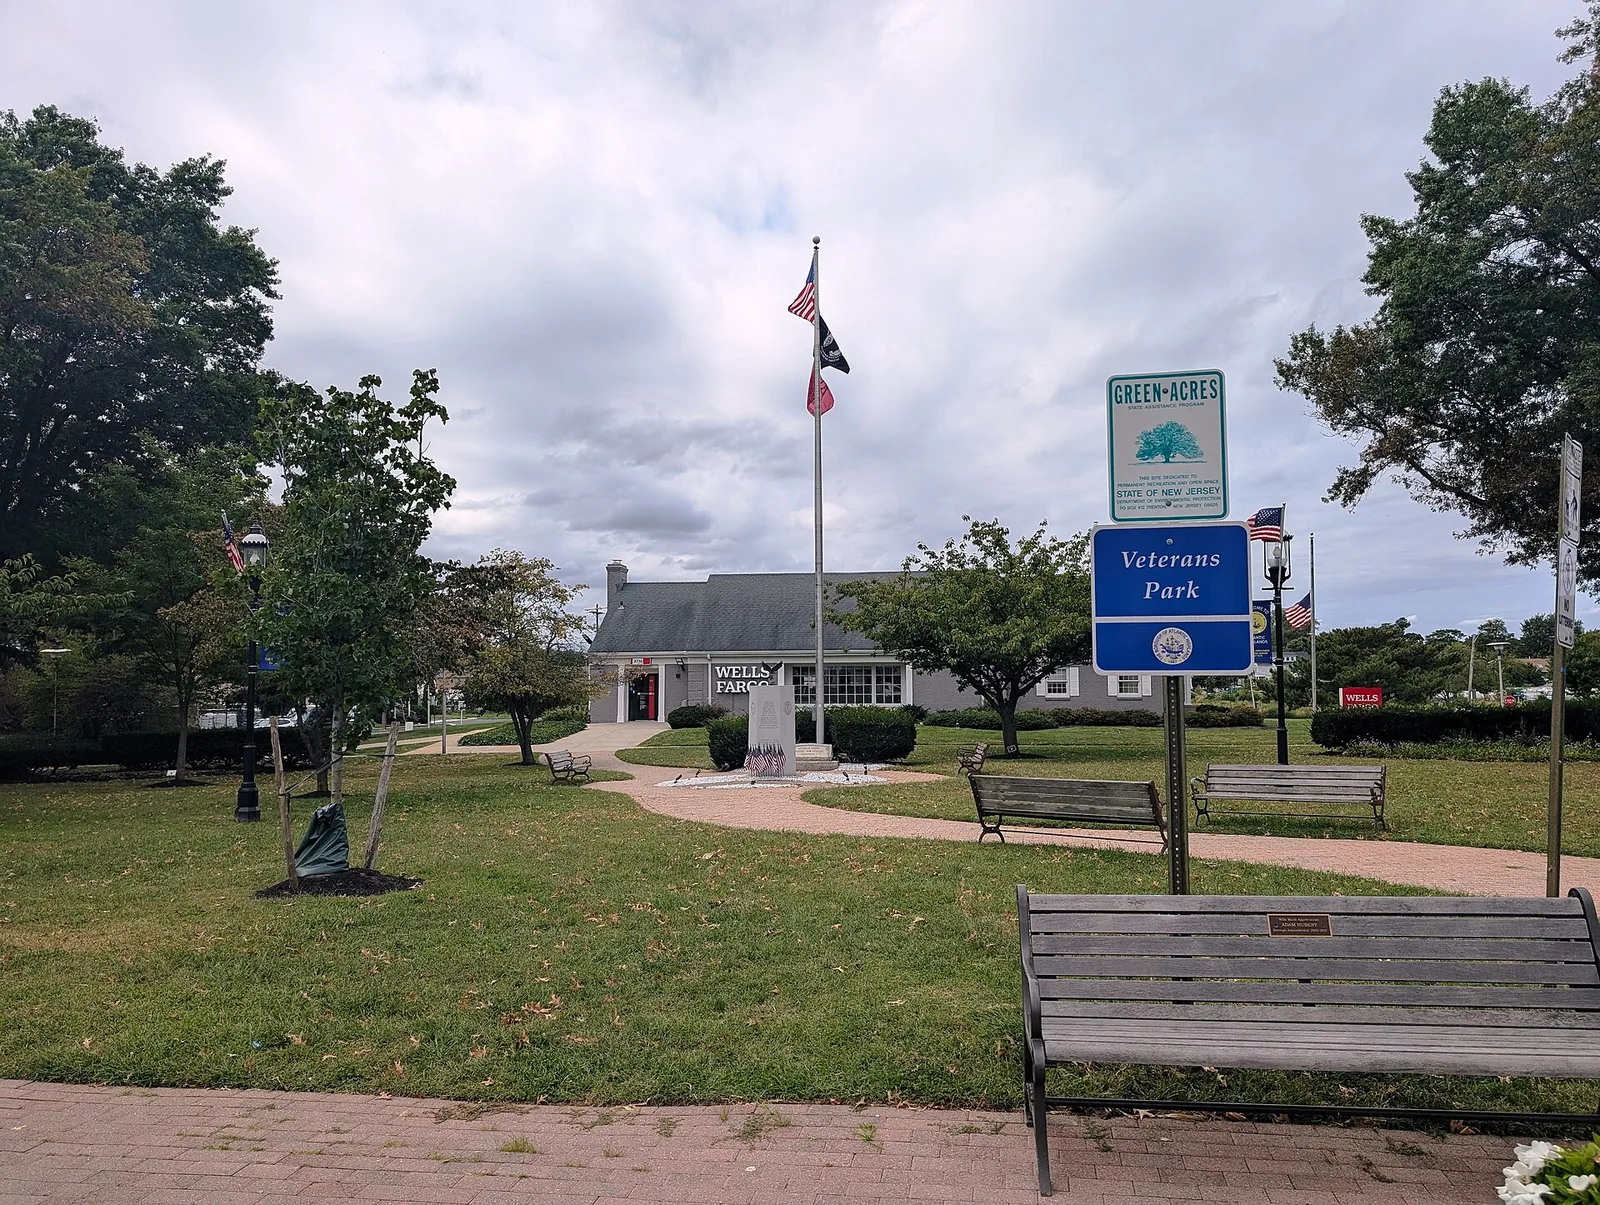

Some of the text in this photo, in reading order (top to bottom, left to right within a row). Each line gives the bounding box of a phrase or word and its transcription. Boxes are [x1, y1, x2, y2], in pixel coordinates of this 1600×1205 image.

[1114, 378, 1218, 405] GREEN ACRES
[1116, 486, 1221, 498] STATE OF NEW JERSEY
[1121, 551, 1221, 569] Veterans
[1143, 580, 1200, 600] Park
[714, 666, 770, 678] WELLS
[1346, 694, 1379, 702] WELLS
